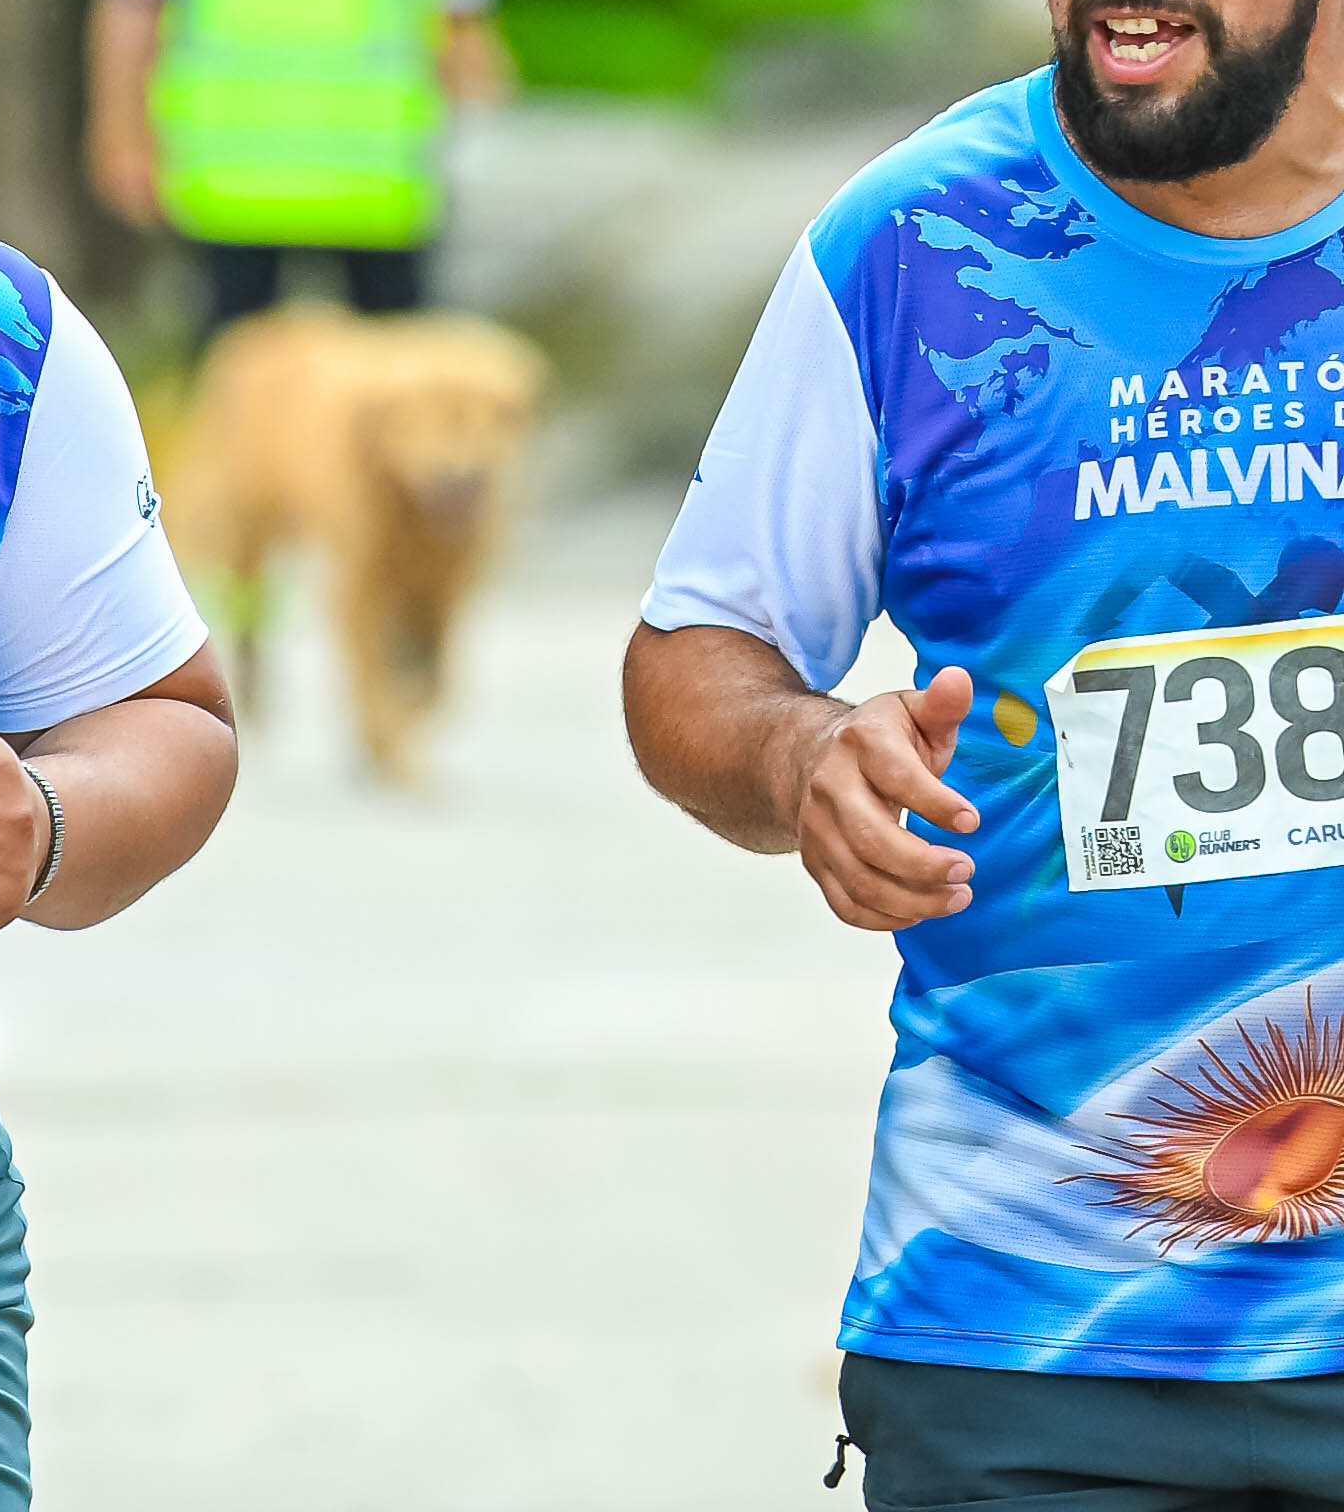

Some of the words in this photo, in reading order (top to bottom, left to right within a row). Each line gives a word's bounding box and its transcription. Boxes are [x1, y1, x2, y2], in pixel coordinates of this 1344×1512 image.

[1109, 353, 1344, 407] MARATÓ
[1110, 406, 1305, 444] HÉROES
[1074, 441, 1344, 521] MALVIN
[1072, 646, 1344, 823] 738
[1199, 830, 1231, 844] CLUB
[1199, 839, 1261, 856] RUNNER'S
